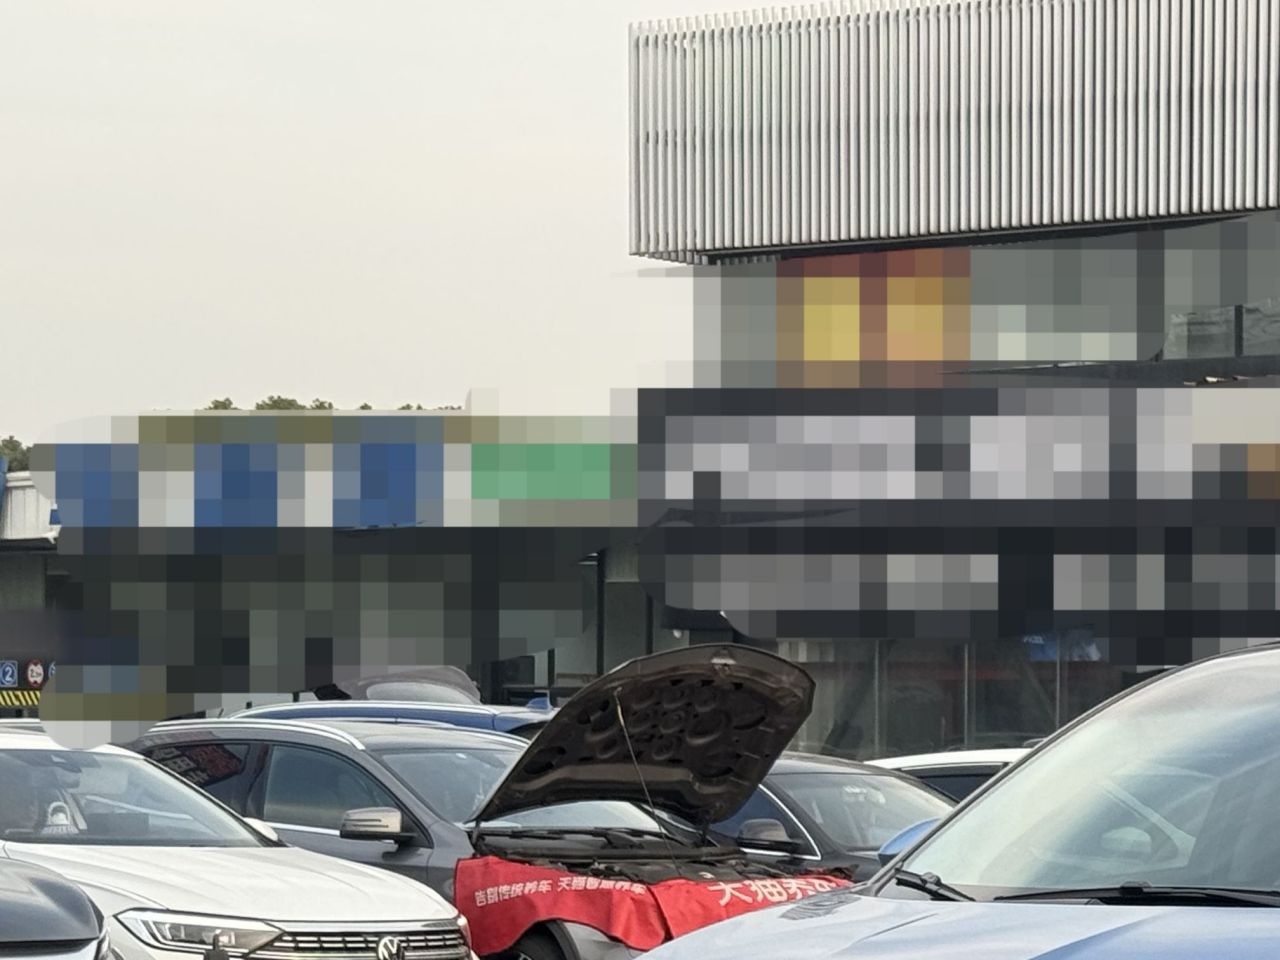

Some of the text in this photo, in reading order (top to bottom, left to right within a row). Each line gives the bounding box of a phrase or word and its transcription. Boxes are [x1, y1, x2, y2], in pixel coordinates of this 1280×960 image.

[4, 666, 13, 681] 2
[475, 880, 552, 907] 告别传统养车
